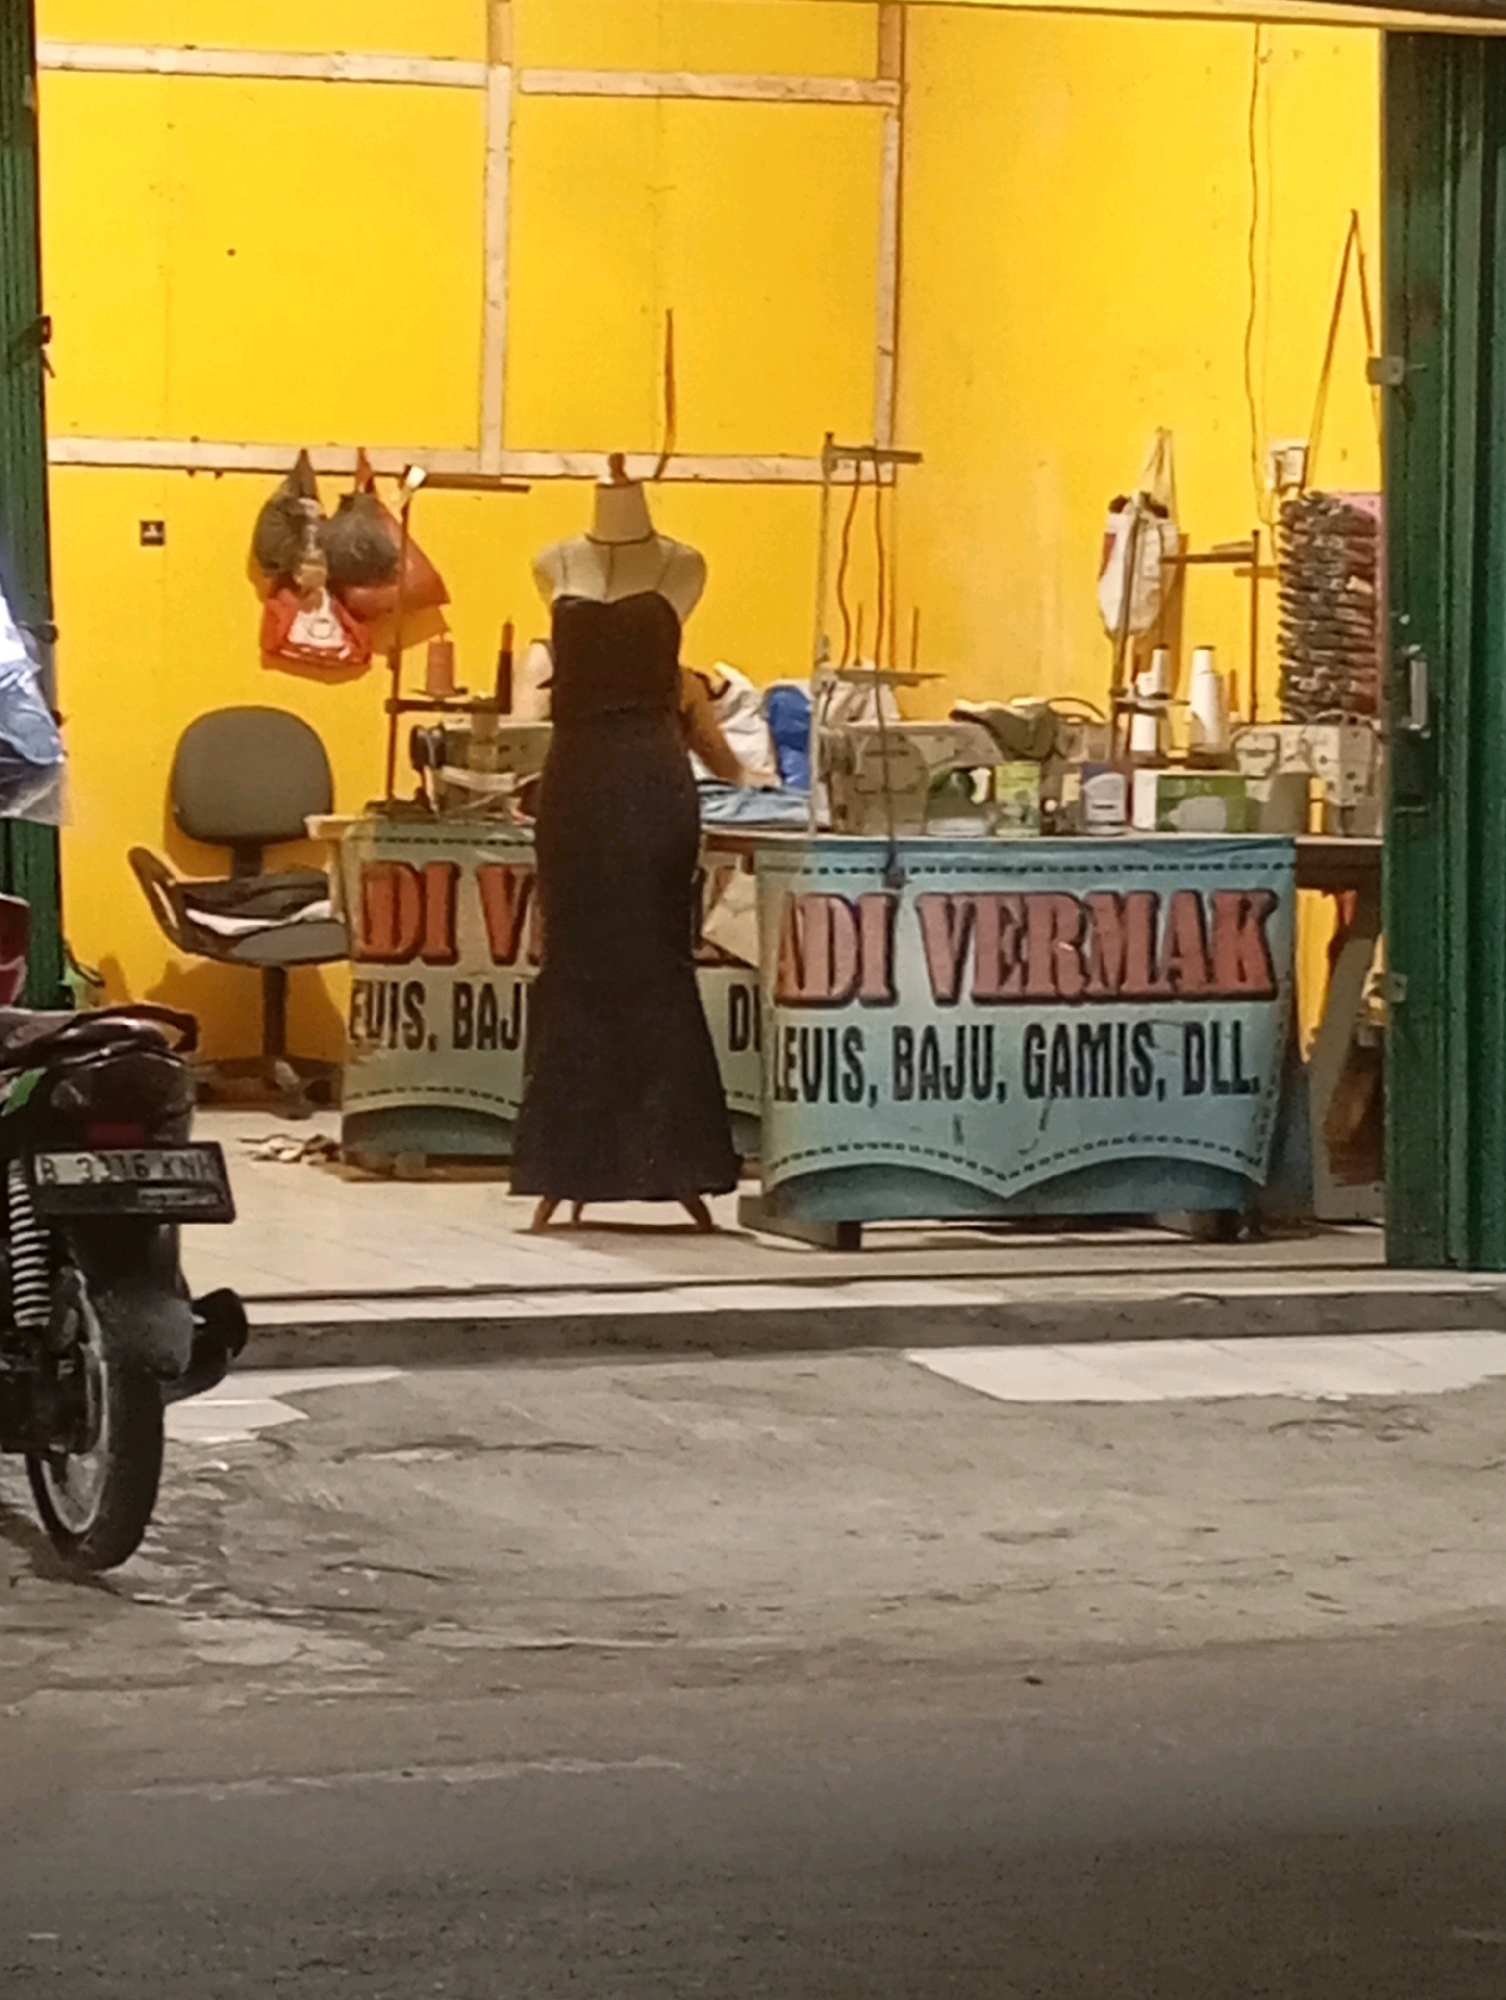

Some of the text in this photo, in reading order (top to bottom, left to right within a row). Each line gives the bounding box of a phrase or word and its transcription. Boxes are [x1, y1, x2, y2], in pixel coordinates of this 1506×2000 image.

[774, 888, 1278, 1007] ADI VERMAK
[452, 981, 523, 1050] BAJ
[891, 1023, 1007, 1104] BAJU,
[1022, 1021, 1167, 1101] GAMIS,
[1182, 1020, 1261, 1096] DLL.
